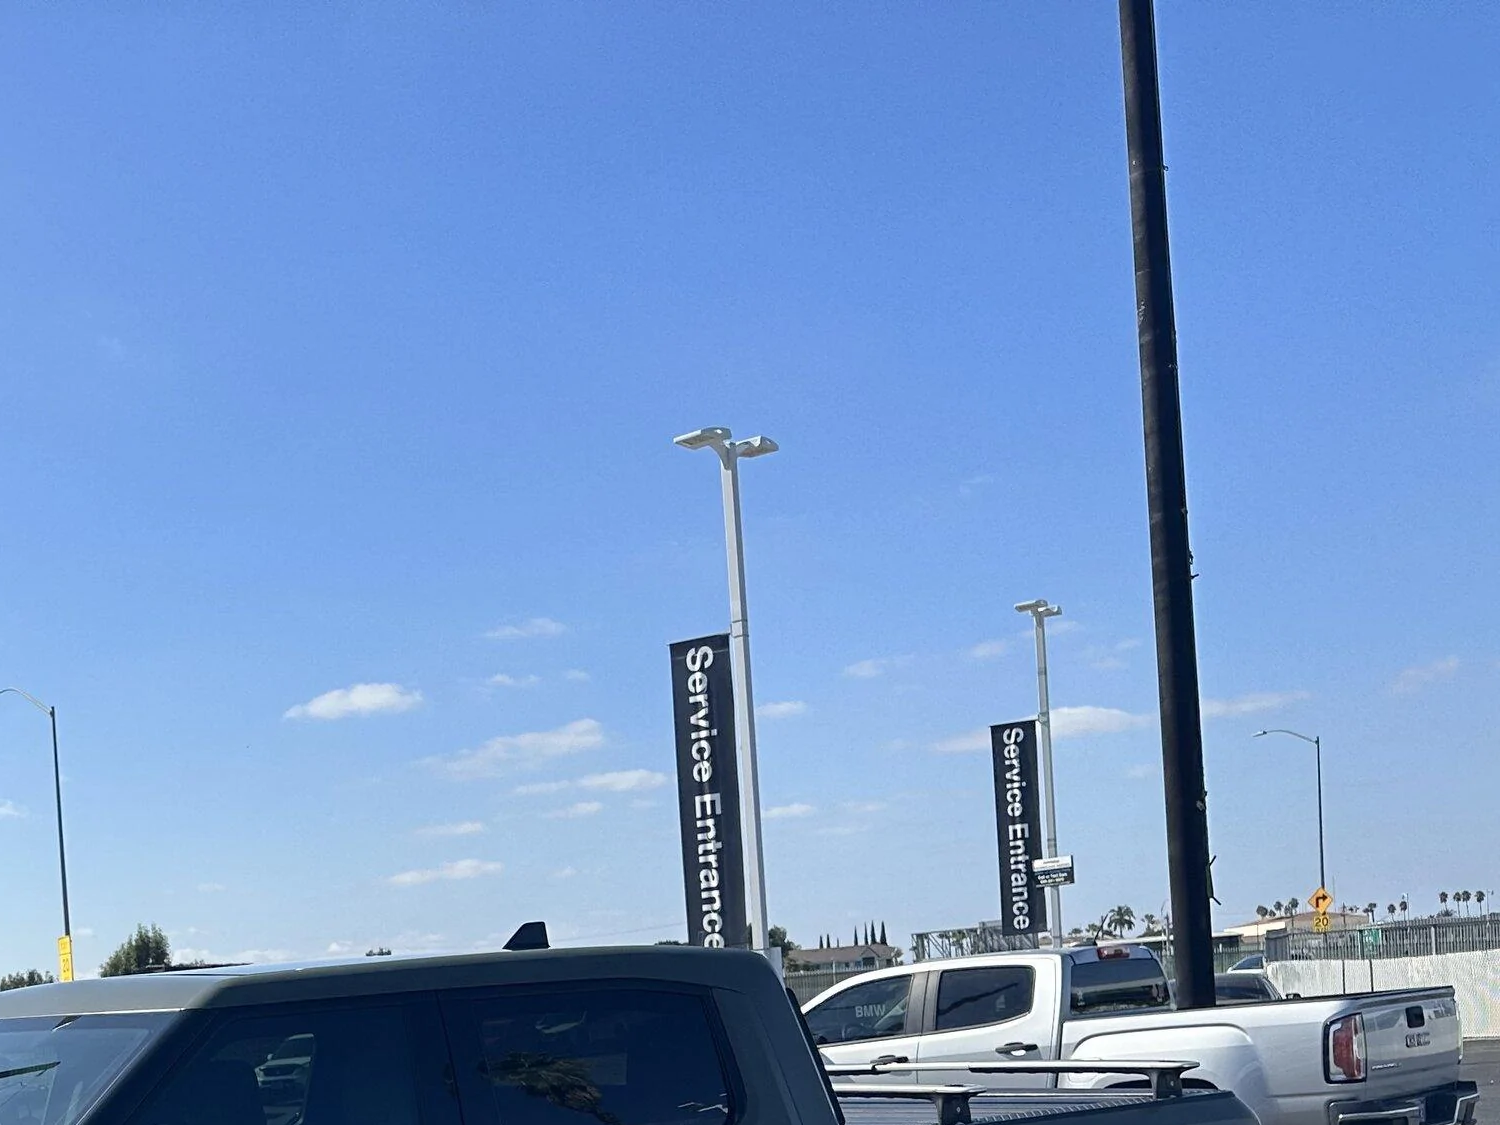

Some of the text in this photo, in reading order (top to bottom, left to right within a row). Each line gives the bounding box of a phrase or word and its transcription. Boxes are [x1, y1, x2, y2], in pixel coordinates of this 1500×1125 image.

[685, 645, 725, 949] Service Entrance
[1003, 727, 1030, 930] Service Entrance
[1314, 917, 1329, 927] 20
[855, 1004, 886, 1018] BMW
